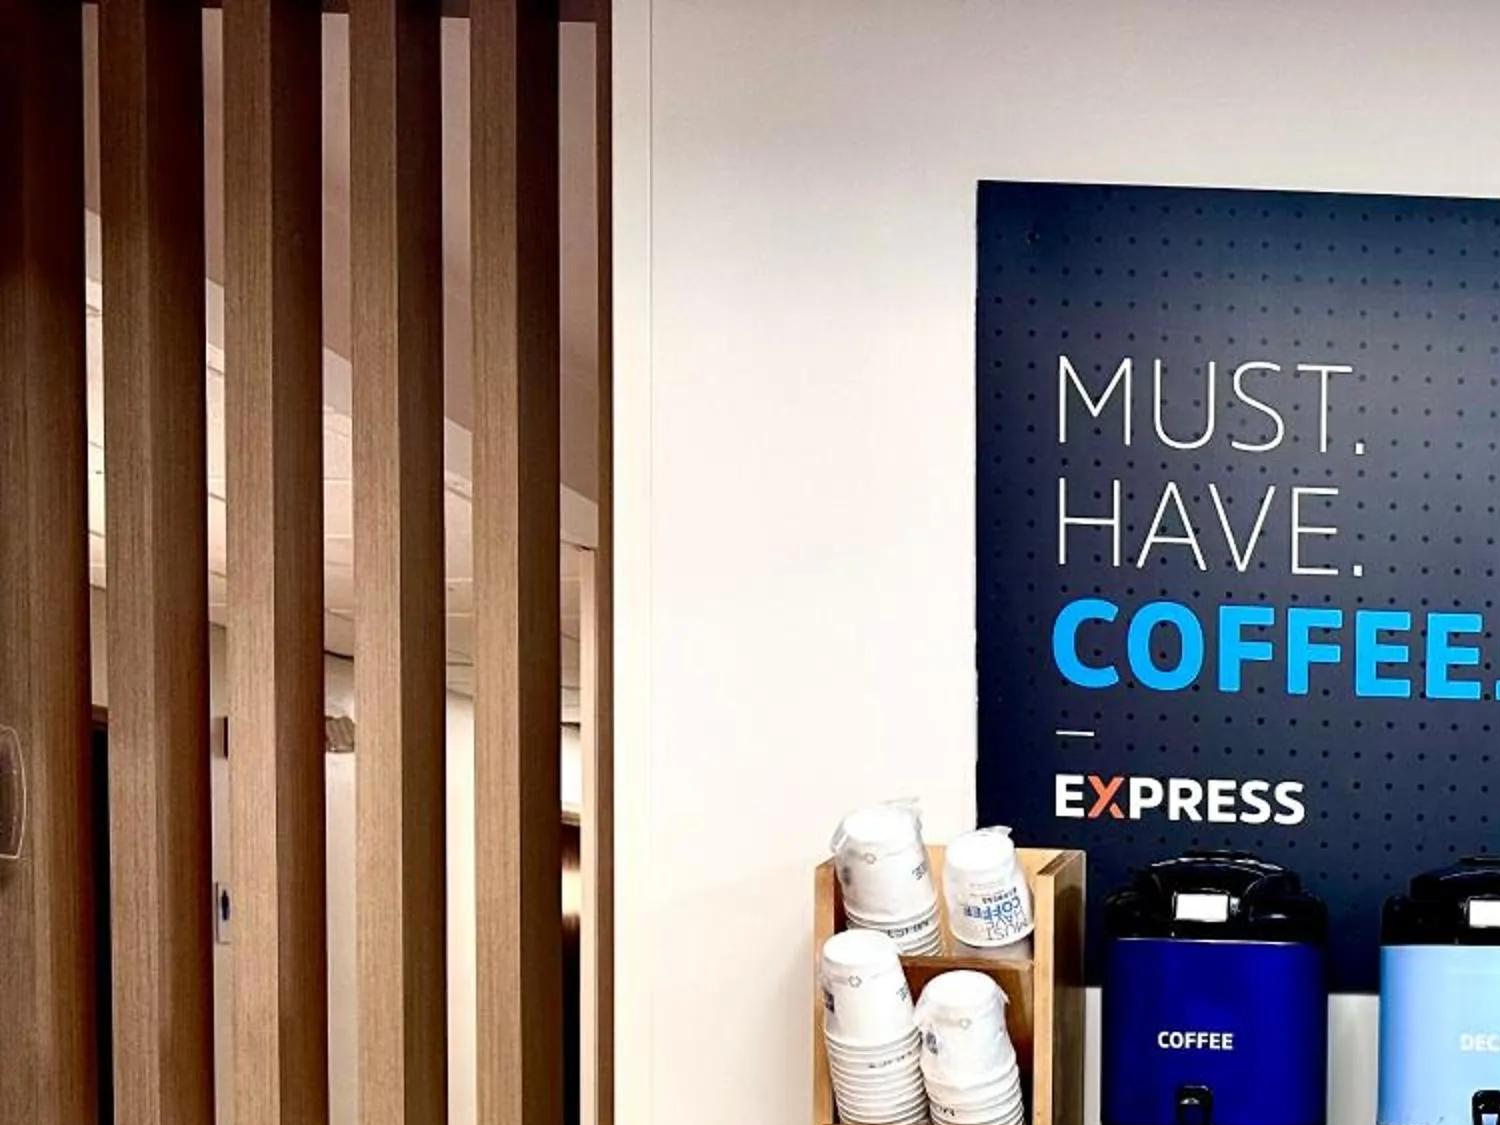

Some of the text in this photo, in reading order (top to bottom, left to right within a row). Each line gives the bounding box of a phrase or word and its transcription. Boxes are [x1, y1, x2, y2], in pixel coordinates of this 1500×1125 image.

[1058, 355, 1365, 455] MUST.
[1057, 477, 1363, 577] HAVE.
[1055, 774, 1305, 825] EXPRESS
[1157, 1031, 1234, 1050] COFFEE
